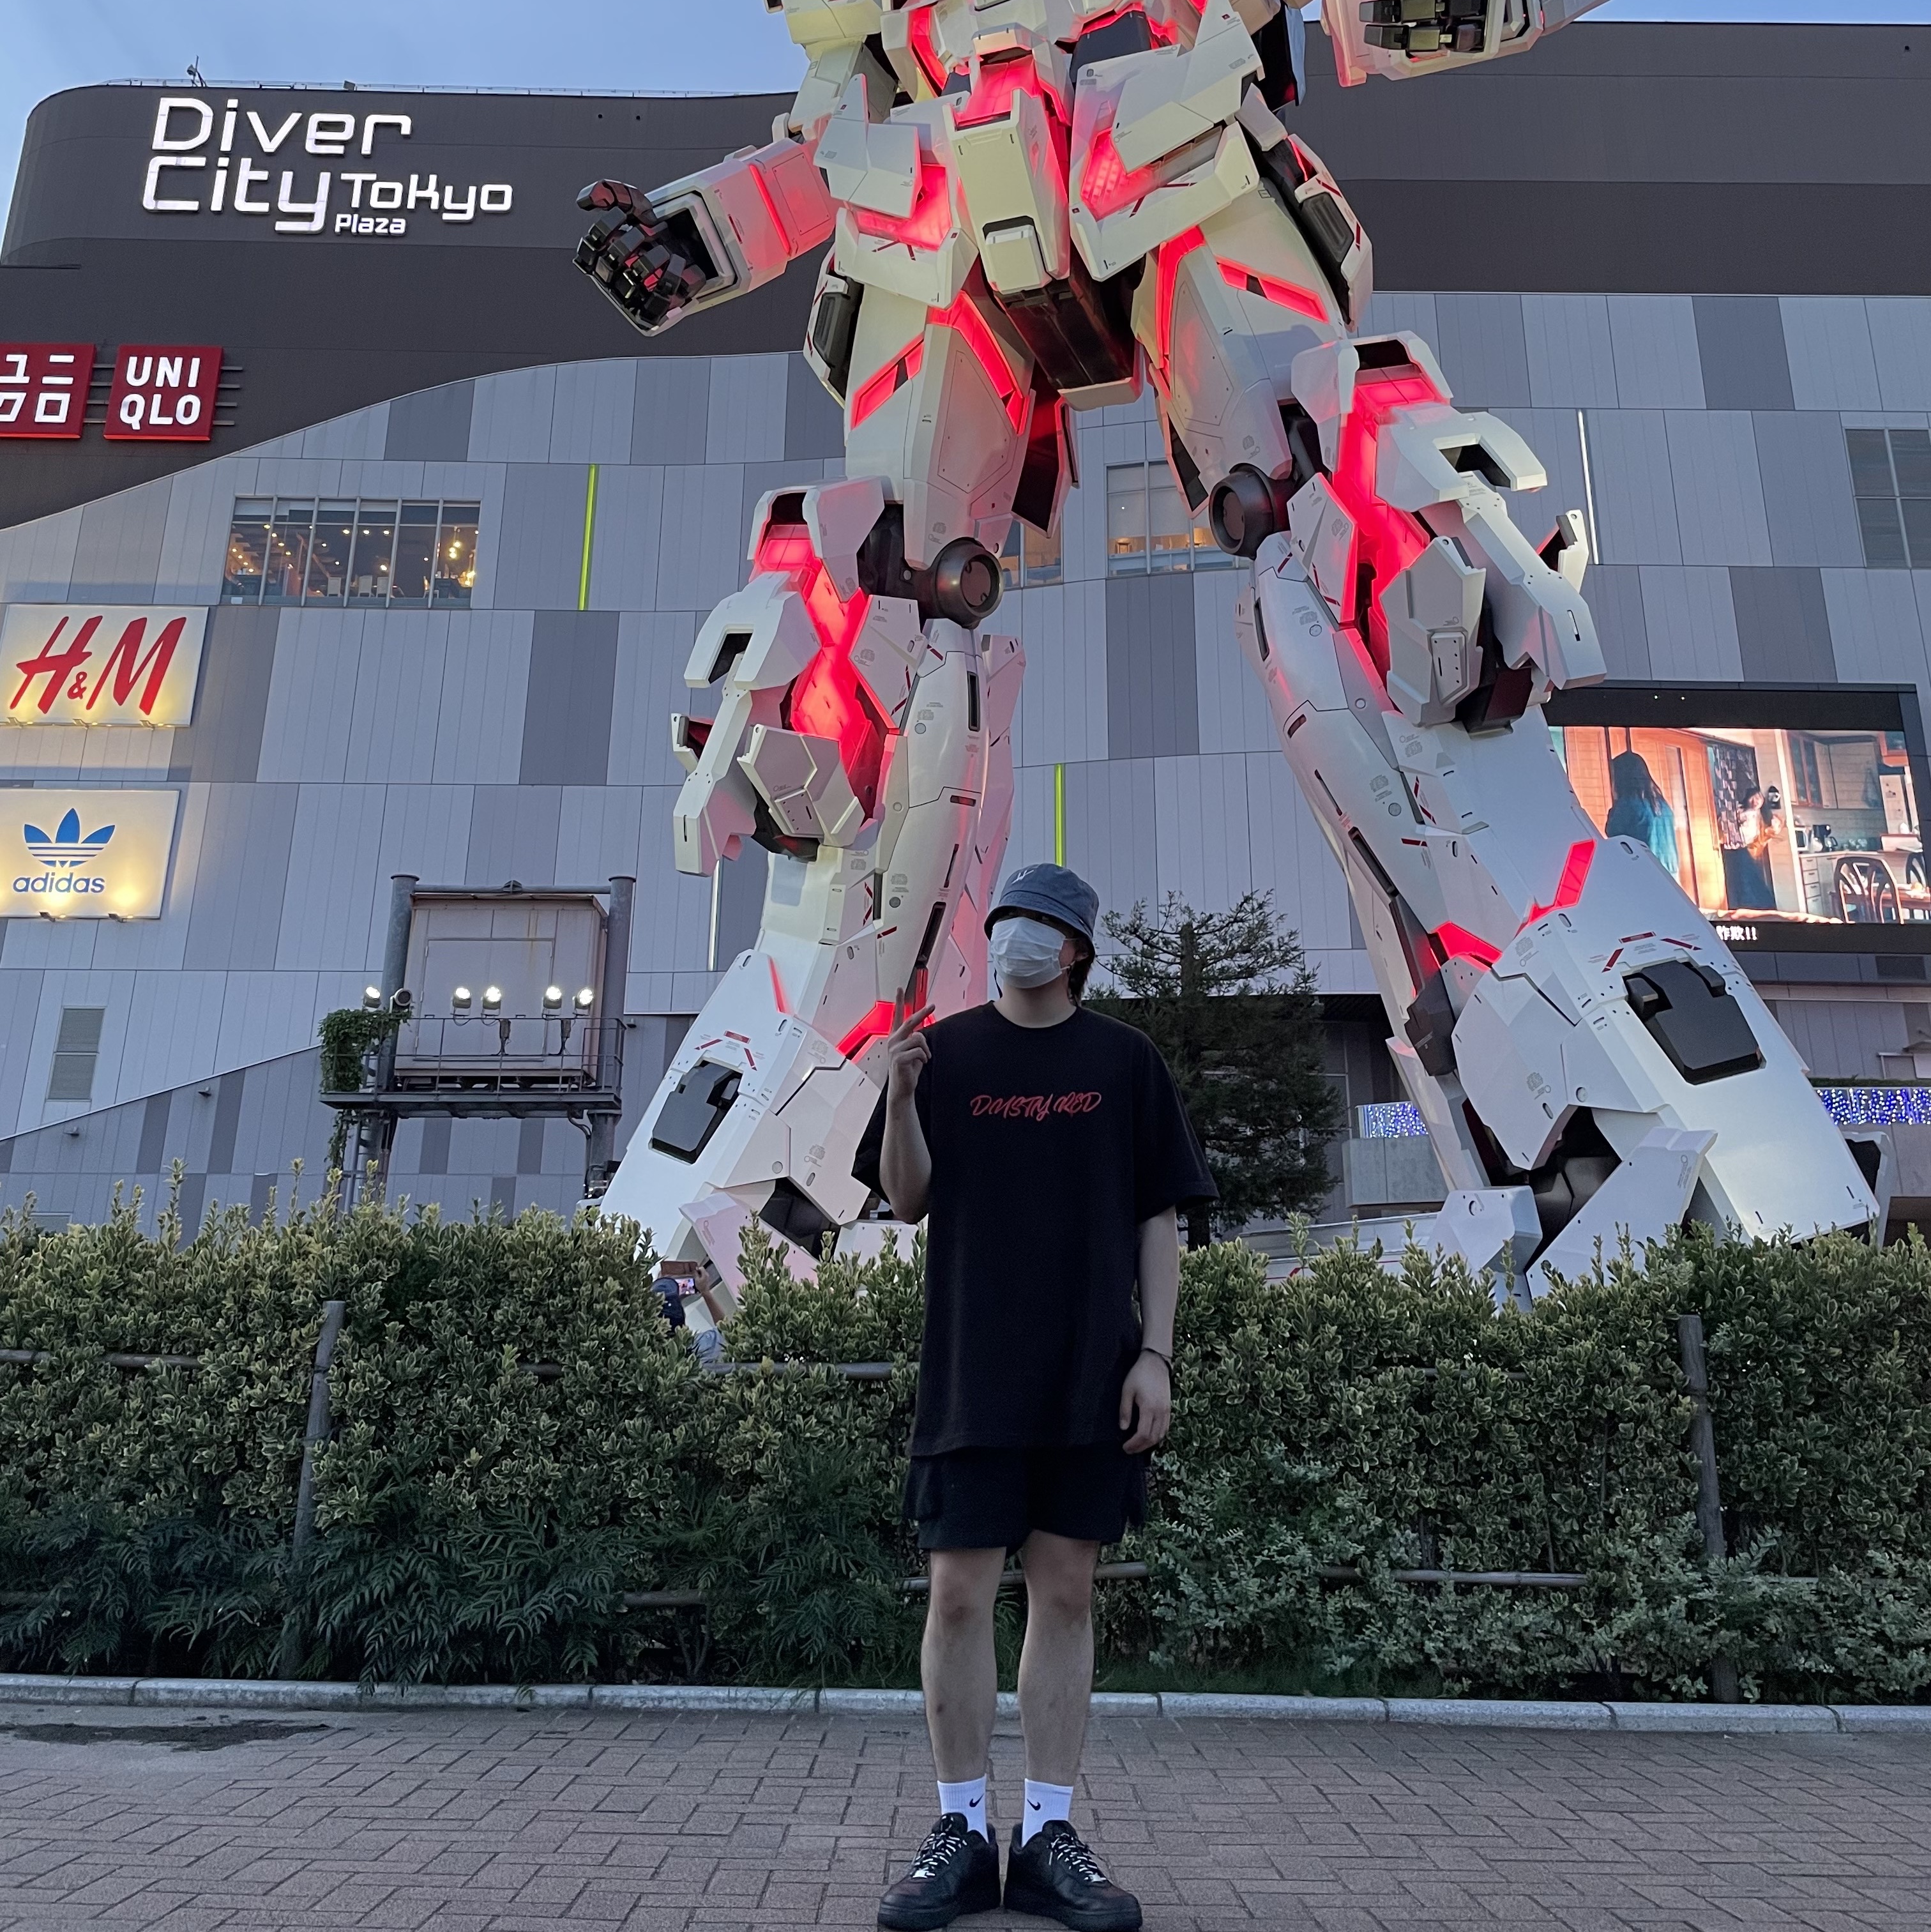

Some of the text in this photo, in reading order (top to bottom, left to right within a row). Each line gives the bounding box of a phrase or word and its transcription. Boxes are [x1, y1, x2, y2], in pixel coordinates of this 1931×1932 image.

[152, 97, 413, 155] Diver
[142, 156, 331, 232] City
[334, 213, 407, 234] Plaza
[126, 356, 201, 388] UNI
[119, 393, 201, 430] QLO
[10, 615, 186, 715] H&M
[13, 872, 105, 894] adidas
